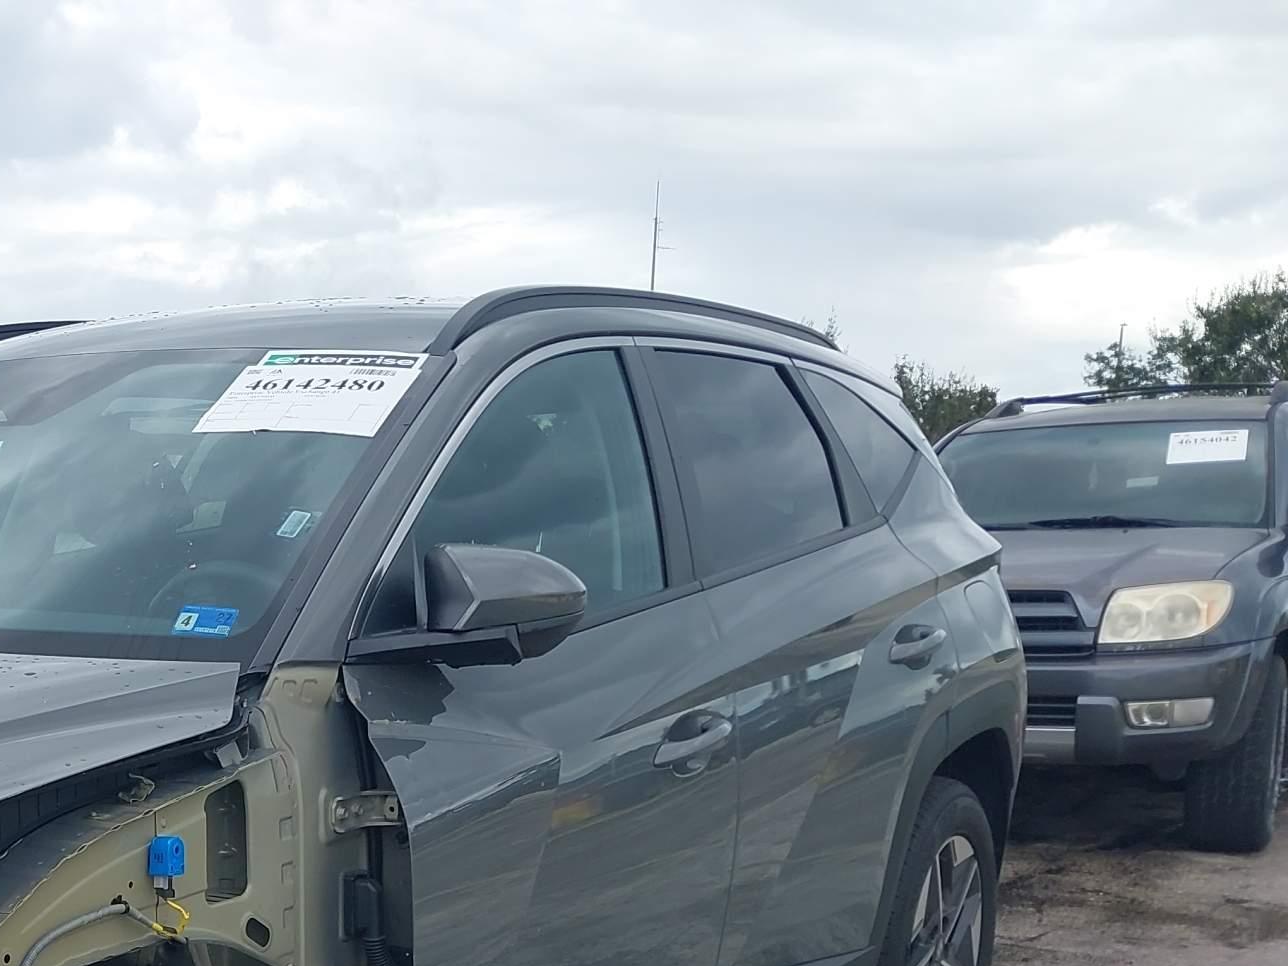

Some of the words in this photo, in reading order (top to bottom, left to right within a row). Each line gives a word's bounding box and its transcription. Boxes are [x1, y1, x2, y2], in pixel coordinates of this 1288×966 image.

[271, 356, 416, 367] enterprise
[245, 377, 385, 392] 46142480
[180, 615, 193, 627] 4
[216, 612, 233, 625] 27
